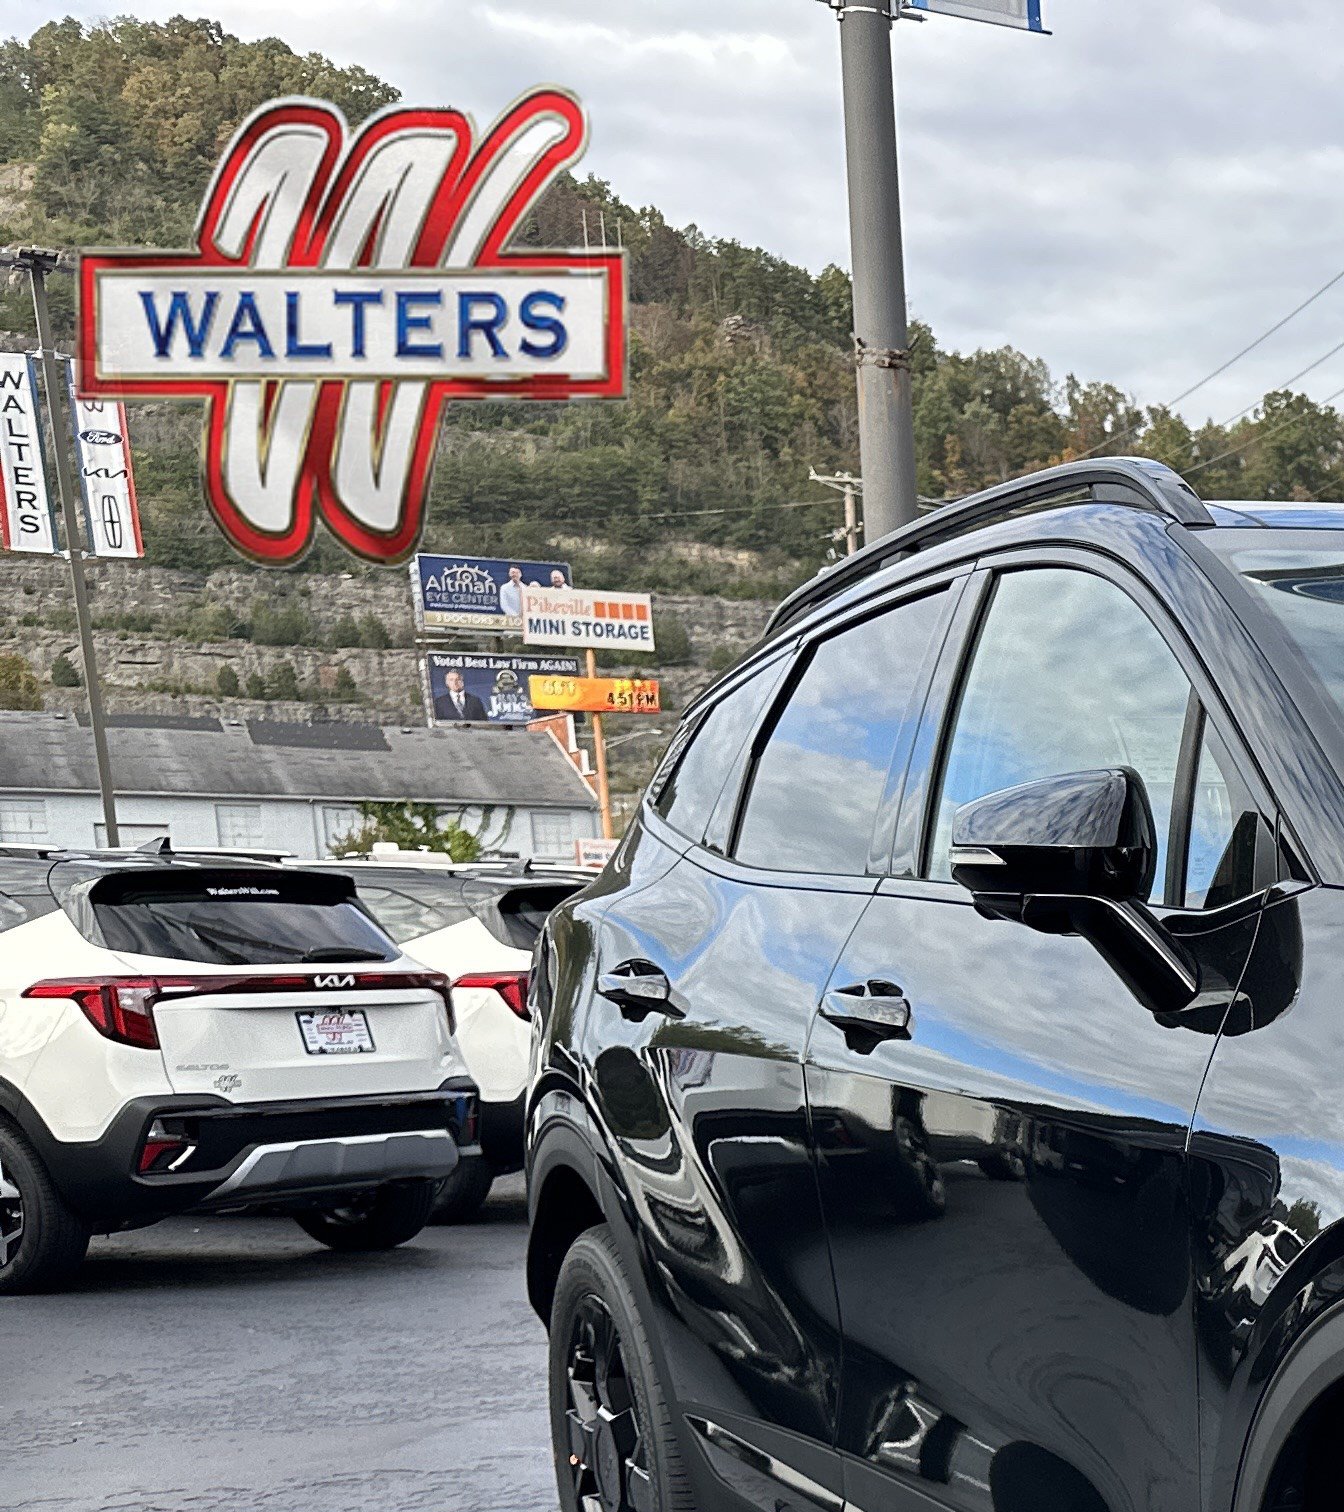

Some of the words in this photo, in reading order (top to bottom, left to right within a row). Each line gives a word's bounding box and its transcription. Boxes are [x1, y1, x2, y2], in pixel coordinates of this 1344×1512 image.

[86, 430, 117, 446] Ford
[0, 370, 40, 535] WALTERS
[425, 573, 498, 596] Altman
[426, 591, 450, 603] EYE
[451, 593, 499, 606] CENTER
[526, 596, 592, 617] Pikeville
[528, 618, 566, 636] MINI
[571, 620, 651, 641] STORAGE
[432, 655, 463, 668] Voted
[464, 656, 488, 669] Best
[488, 657, 511, 670] Law
[511, 658, 538, 671] Firm
